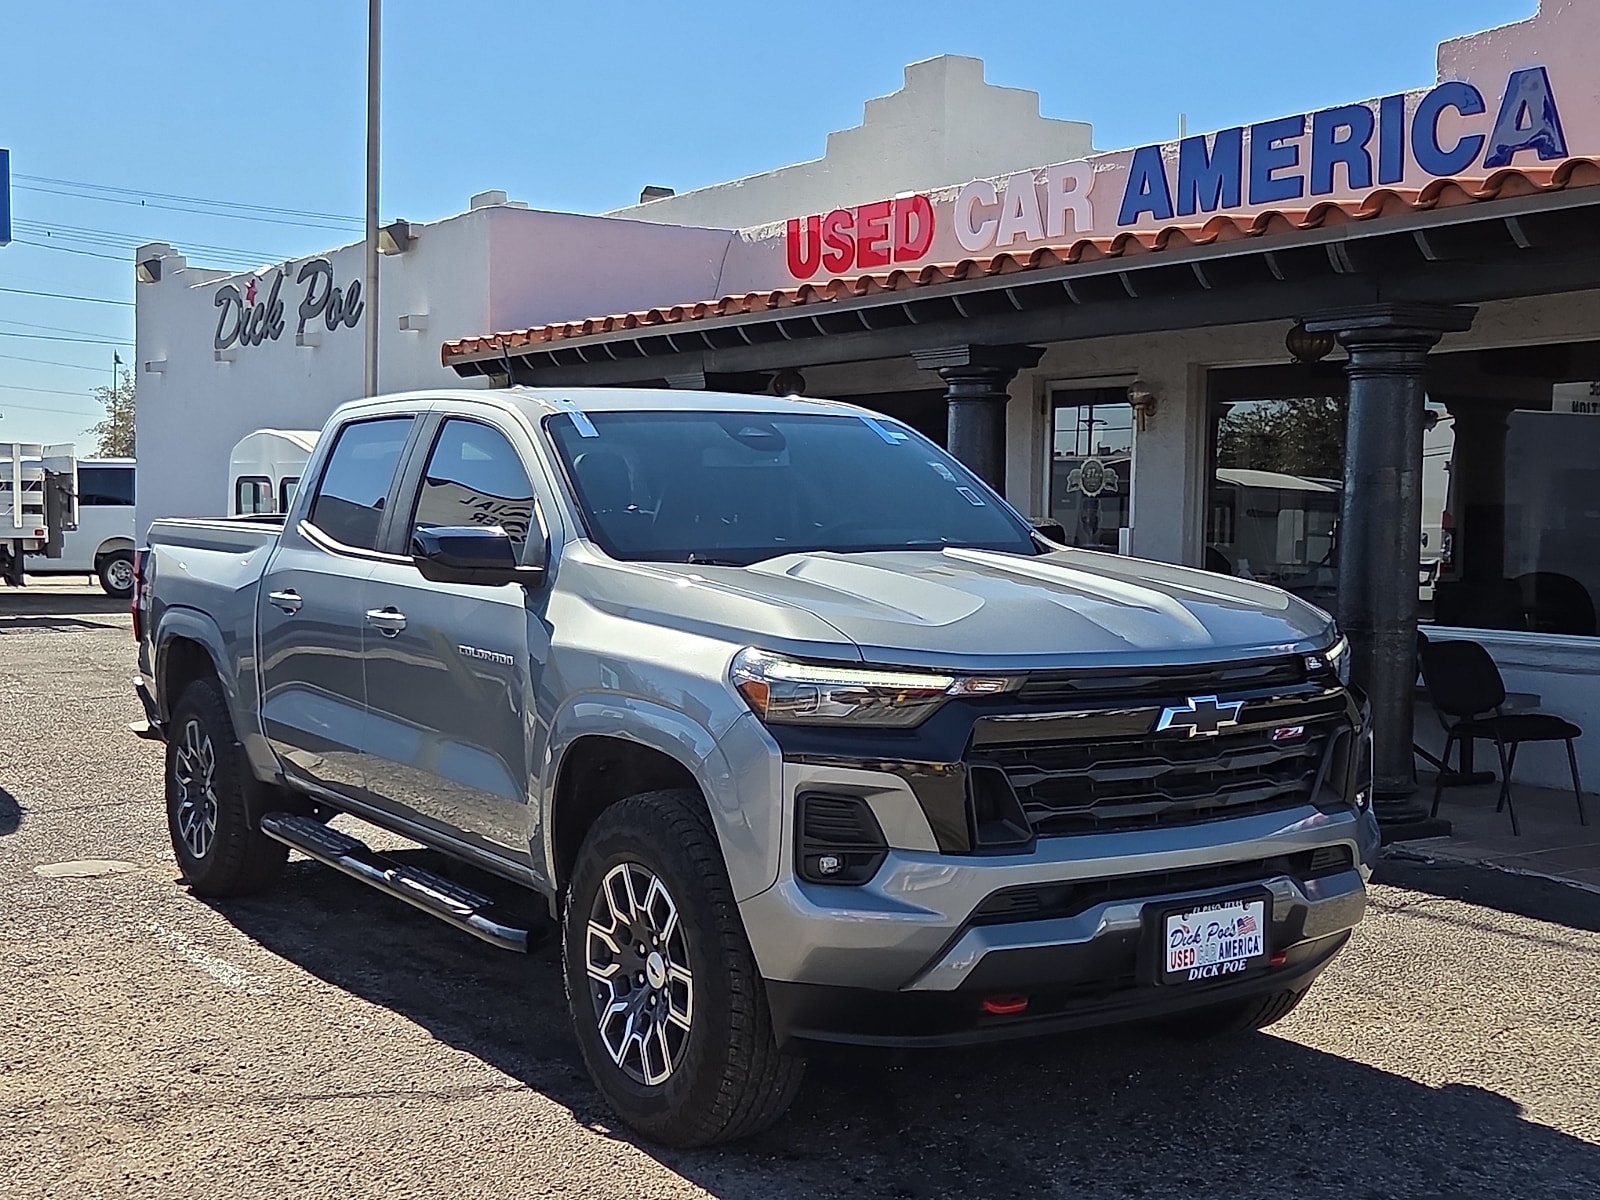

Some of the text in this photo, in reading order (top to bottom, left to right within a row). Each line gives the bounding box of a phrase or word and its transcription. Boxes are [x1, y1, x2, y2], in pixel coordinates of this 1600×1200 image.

[785, 64, 1568, 281] USED CAR AMERICA
[213, 257, 366, 351] Dick Poe
[458, 644, 514, 666] COLORADO
[1170, 924, 1202, 949] Dick
[1170, 947, 1196, 970] USED
[1218, 935, 1260, 961] AMERICA
[1188, 959, 1248, 981] DICK POE
